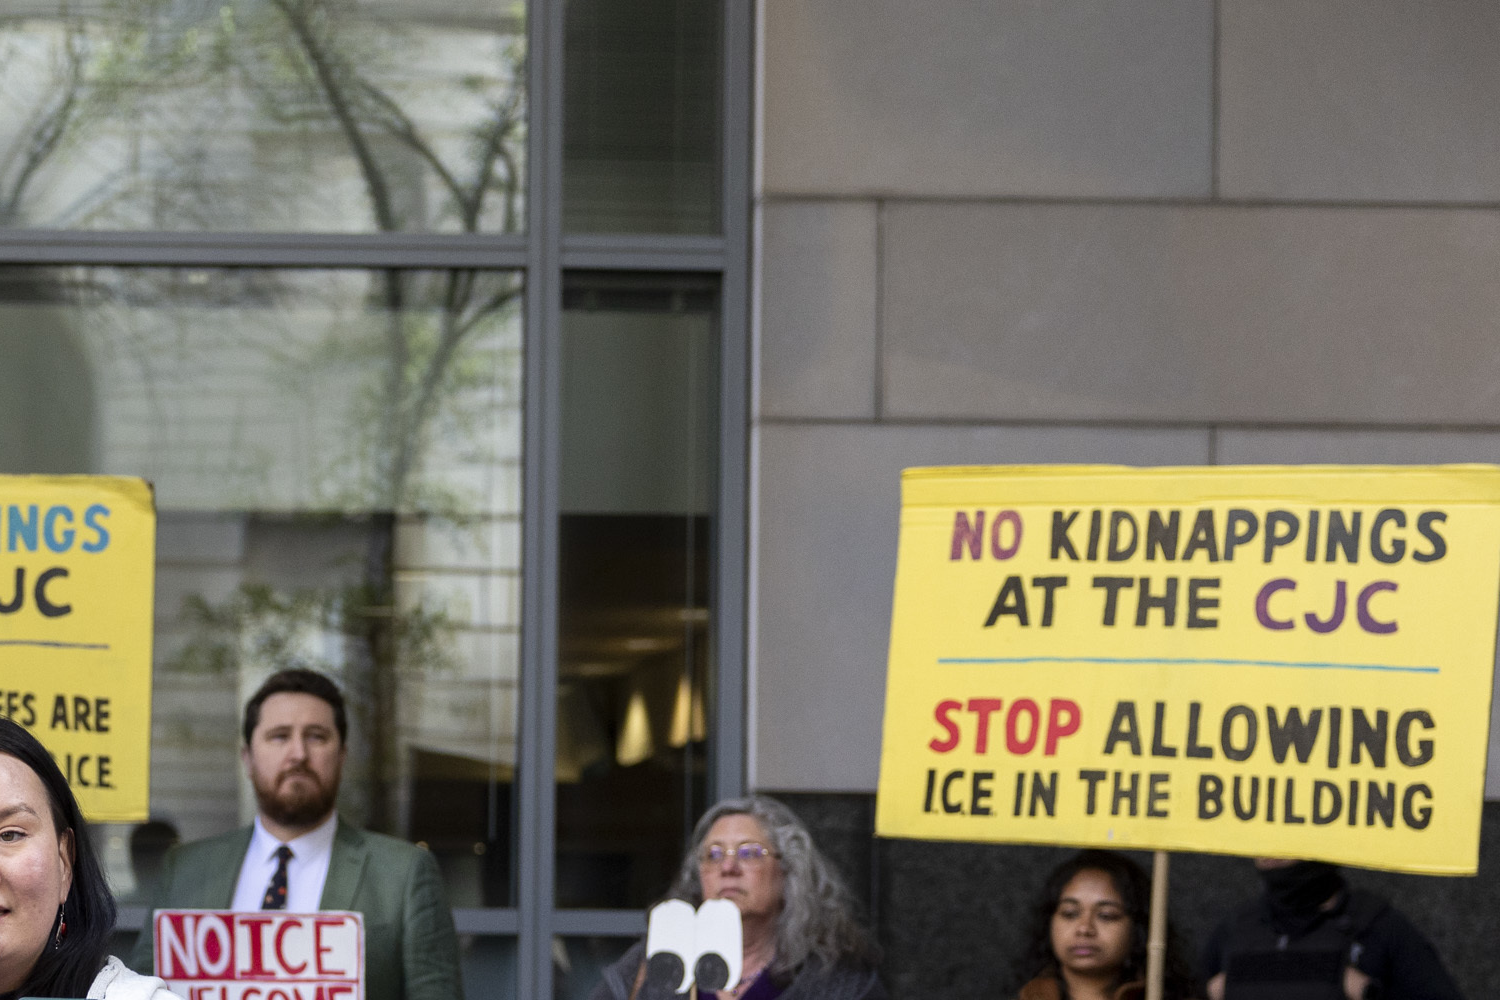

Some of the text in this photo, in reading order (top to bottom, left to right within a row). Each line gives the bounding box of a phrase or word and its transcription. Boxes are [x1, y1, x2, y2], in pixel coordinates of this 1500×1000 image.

[948, 507, 1449, 565] NO KIDNAPPINGS
[983, 574, 1400, 636] AT THE CJC
[50, 694, 112, 734] ARE
[927, 697, 1438, 770] STOP ALLOWING
[1012, 770, 1060, 818] IN
[1078, 769, 1171, 819] THE
[1195, 773, 1435, 831] BUILDING
[159, 914, 347, 977] NO ICE
